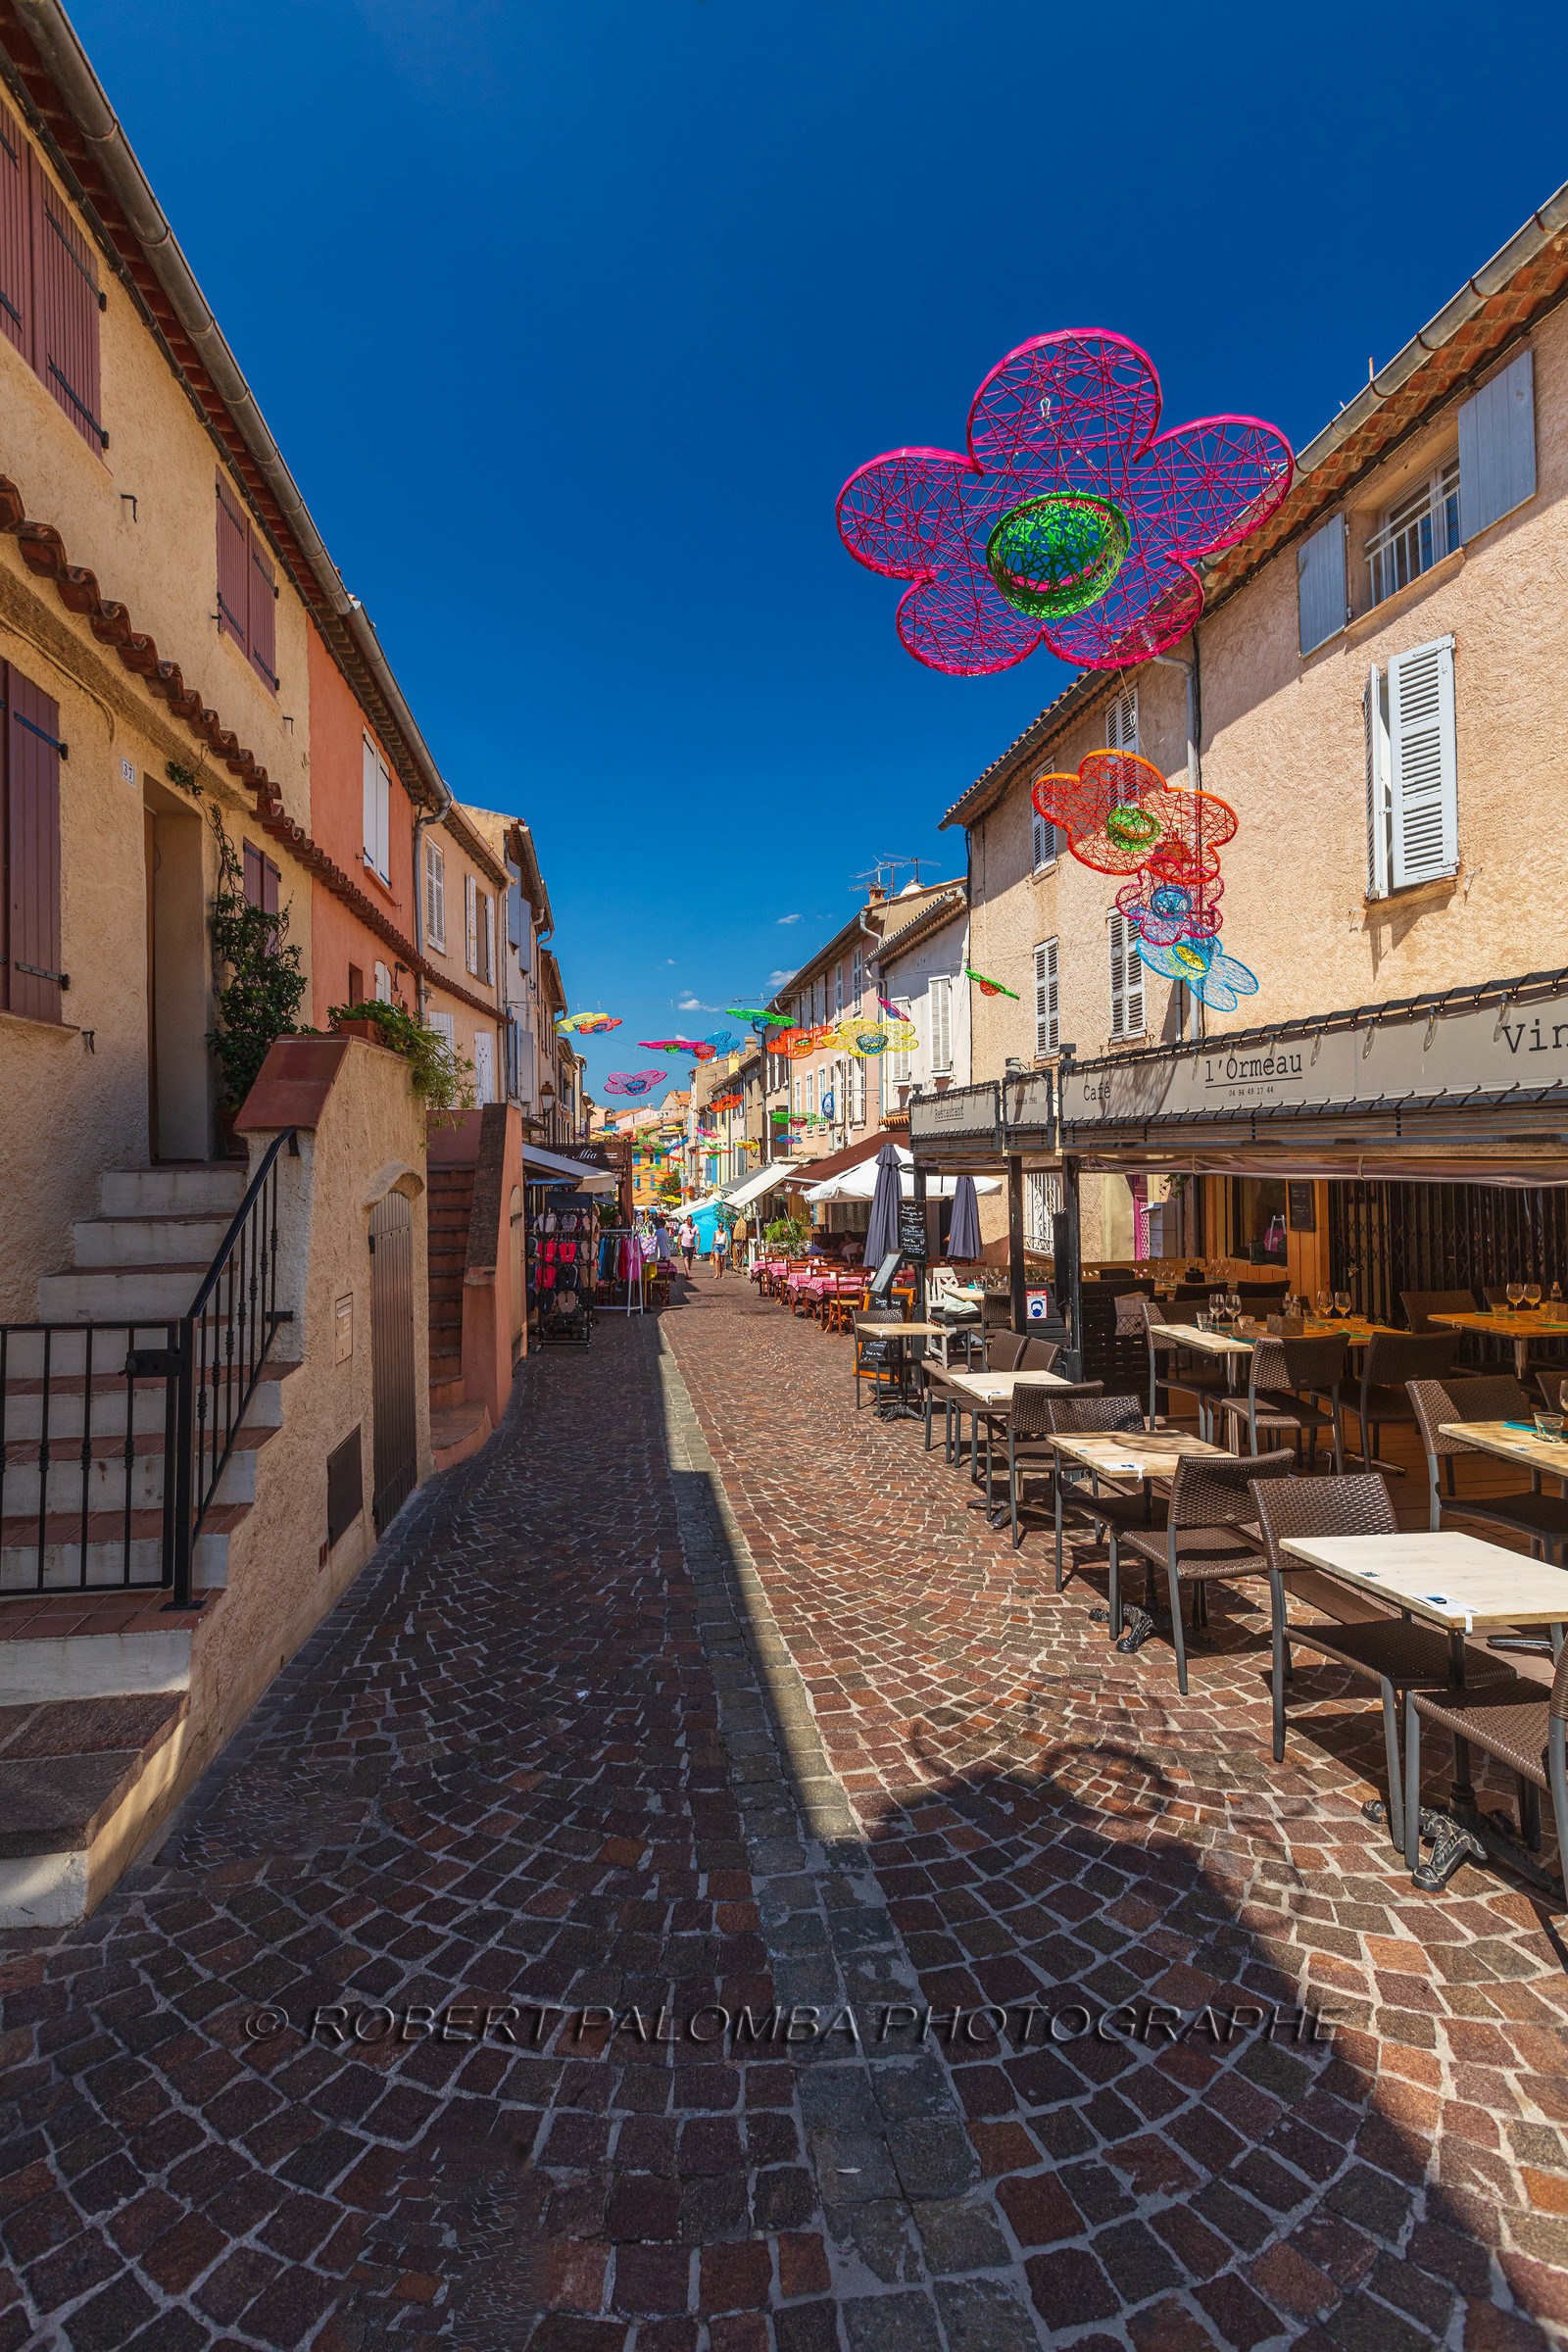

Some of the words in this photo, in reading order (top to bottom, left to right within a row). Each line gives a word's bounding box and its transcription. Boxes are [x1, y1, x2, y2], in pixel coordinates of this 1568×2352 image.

[123, 763, 133, 779] 37
[1205, 1054, 1302, 1082] l'Ormeau
[1083, 1081, 1111, 1102] Café
[1229, 1089, 1236, 1098] 04
[1238, 1088, 1245, 1097] 94
[1248, 1087, 1254, 1096] 49
[1256, 1086, 1264, 1095] 17
[935, 1106, 964, 1119] Restaurant
[572, 1149, 598, 1160] Mia
